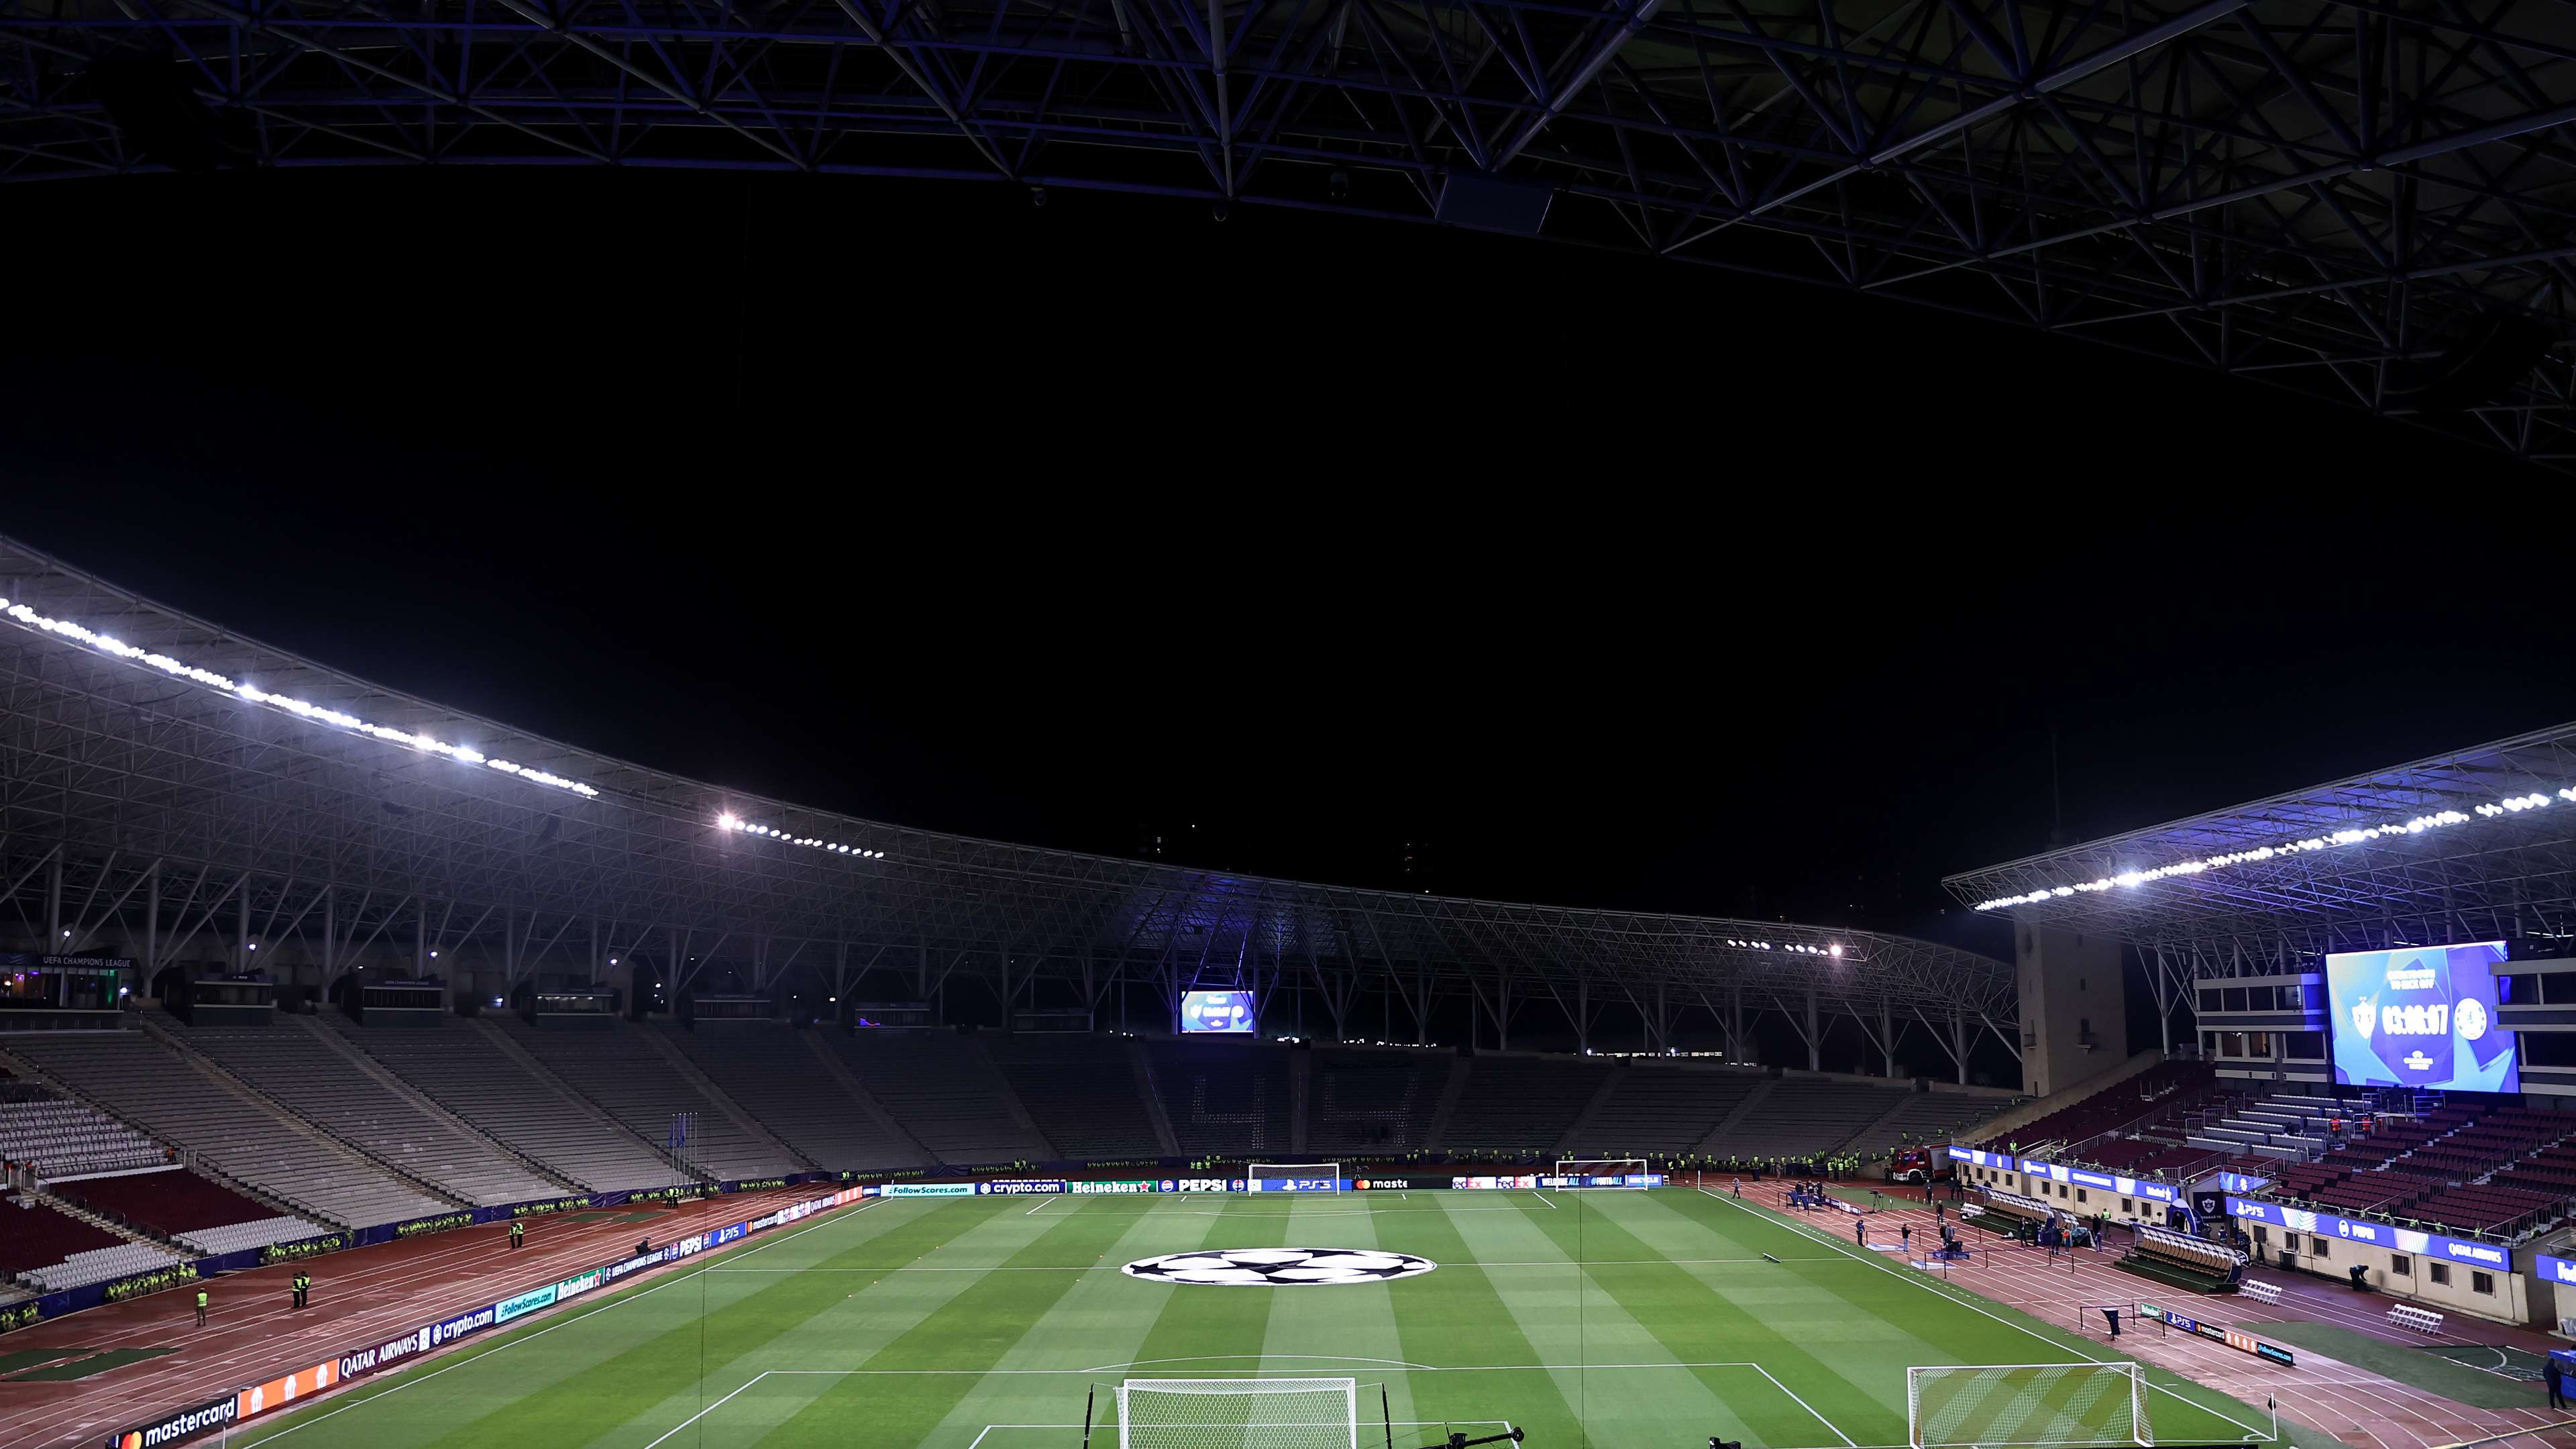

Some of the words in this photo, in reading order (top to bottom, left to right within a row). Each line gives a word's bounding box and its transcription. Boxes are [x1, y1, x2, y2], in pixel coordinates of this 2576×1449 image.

[43, 956, 62, 965] UEFA
[63, 957, 103, 966] CHAMPIONS
[105, 959, 131, 967] LEAGUE
[994, 1181, 1059, 1193] crypto.com
[1073, 1181, 1137, 1193] Heineken
[1179, 1179, 1226, 1191] PEPSI
[1542, 1177, 1568, 1186] WELCOME
[1568, 1177, 1579, 1185] ALL
[2245, 1205, 2265, 1218] PS5
[725, 1226, 739, 1238] PS5
[680, 1236, 702, 1257] PEPSI
[612, 1261, 623, 1277] UEFA
[623, 1254, 647, 1273] CHAMPIONS
[647, 1250, 663, 1265] LEAGUE
[557, 1275, 594, 1301] Heineken
[504, 1293, 551, 1316] FollowScores.com
[443, 1309, 492, 1338] crypto.com
[2177, 1317, 2190, 1328] PS5
[2201, 1326, 2224, 1339] mastercard
[341, 1349, 376, 1378] QATAR
[378, 1334, 417, 1363] AIRWAYS
[146, 1397, 235, 1447] mastercard
